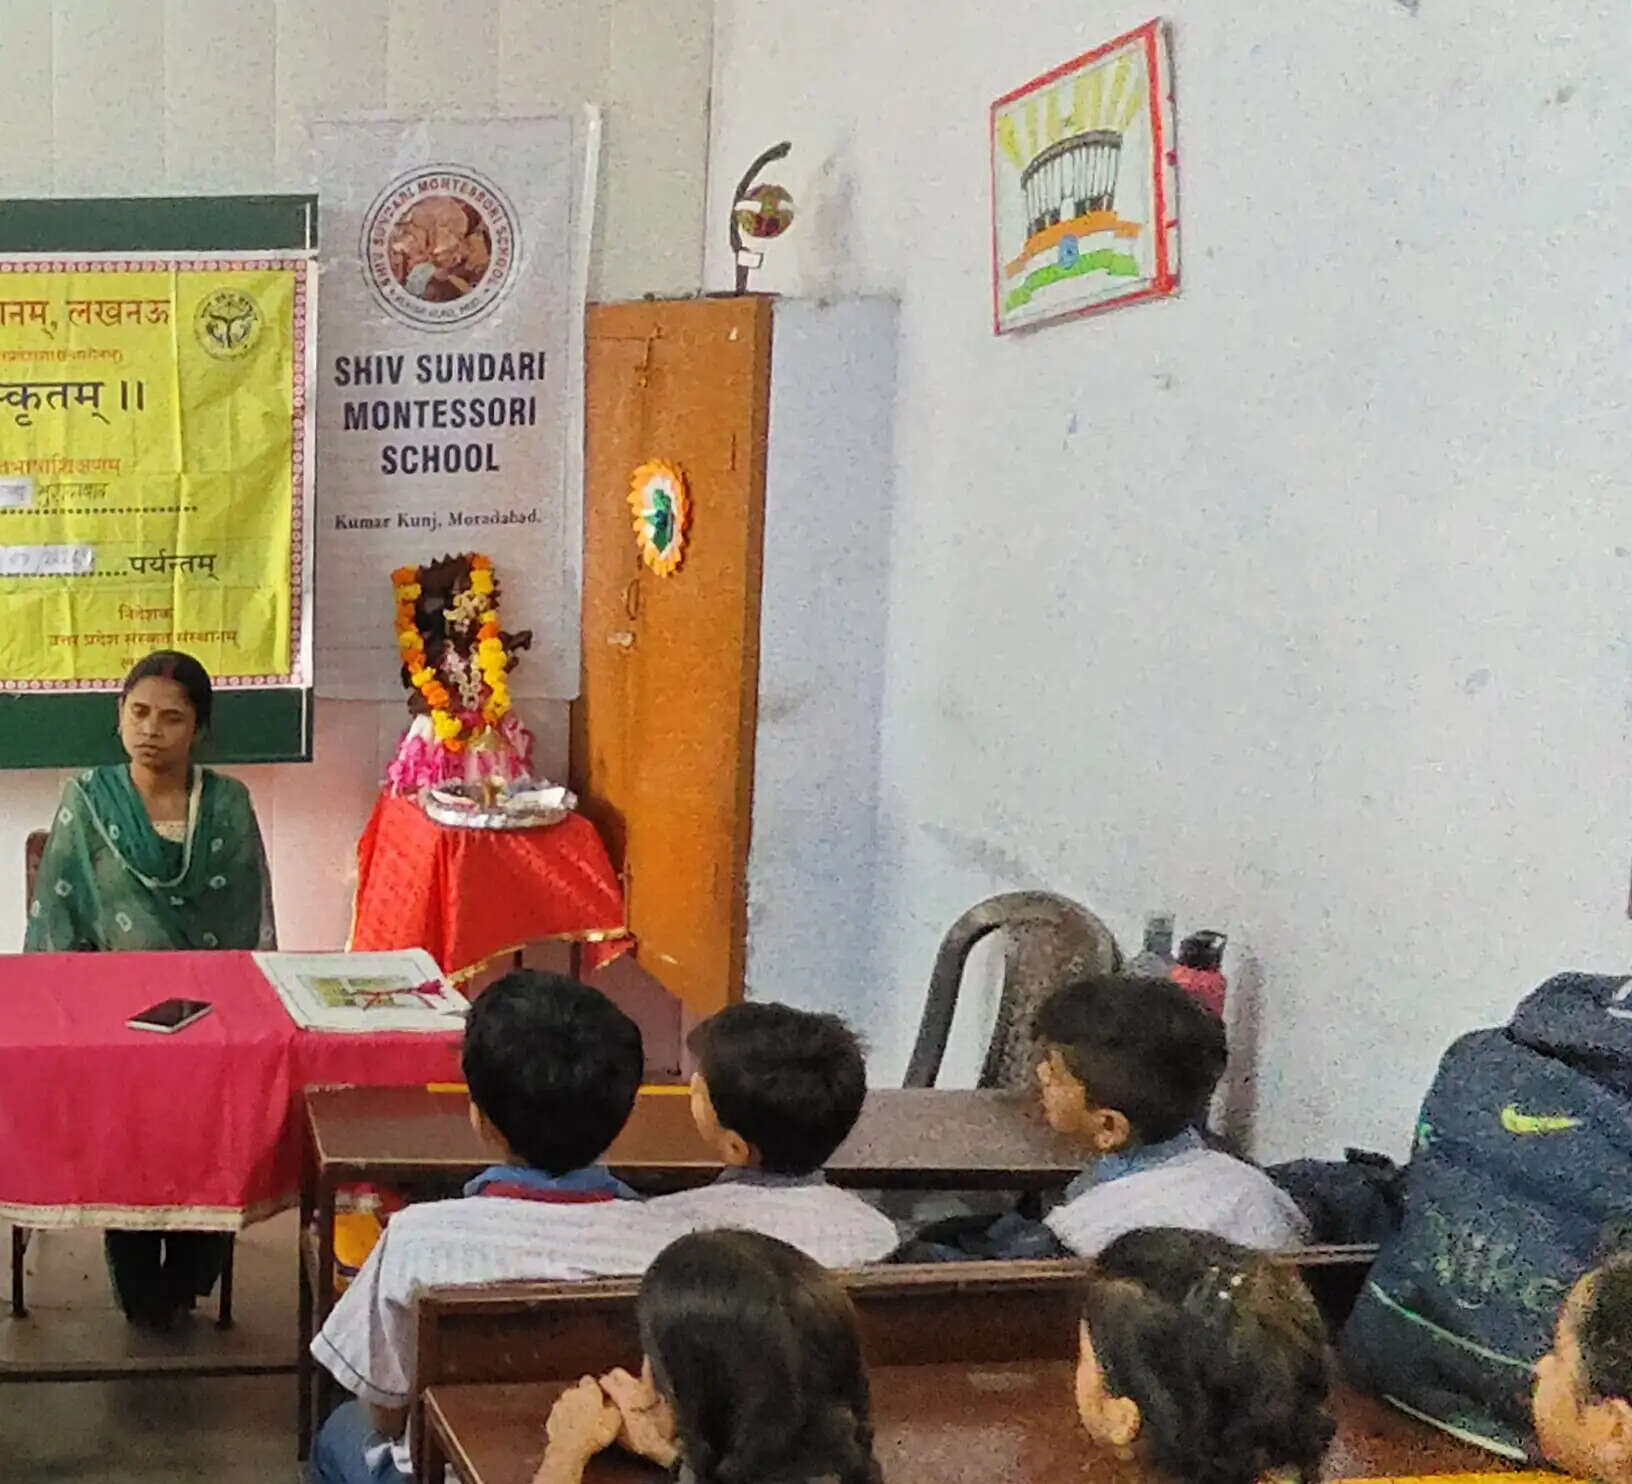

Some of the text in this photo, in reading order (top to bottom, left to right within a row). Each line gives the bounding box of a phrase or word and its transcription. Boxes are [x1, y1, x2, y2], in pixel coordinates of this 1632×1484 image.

[66, 299, 171, 327] लखनऊ
[334, 350, 546, 386] SHIV SUNDARI
[343, 395, 537, 431] MONTESSORI
[380, 442, 500, 475] SCHOOL
[334, 508, 542, 532] Kumar Kunj, Moradabad.
[128, 549, 220, 581] पर्यन्तम्
